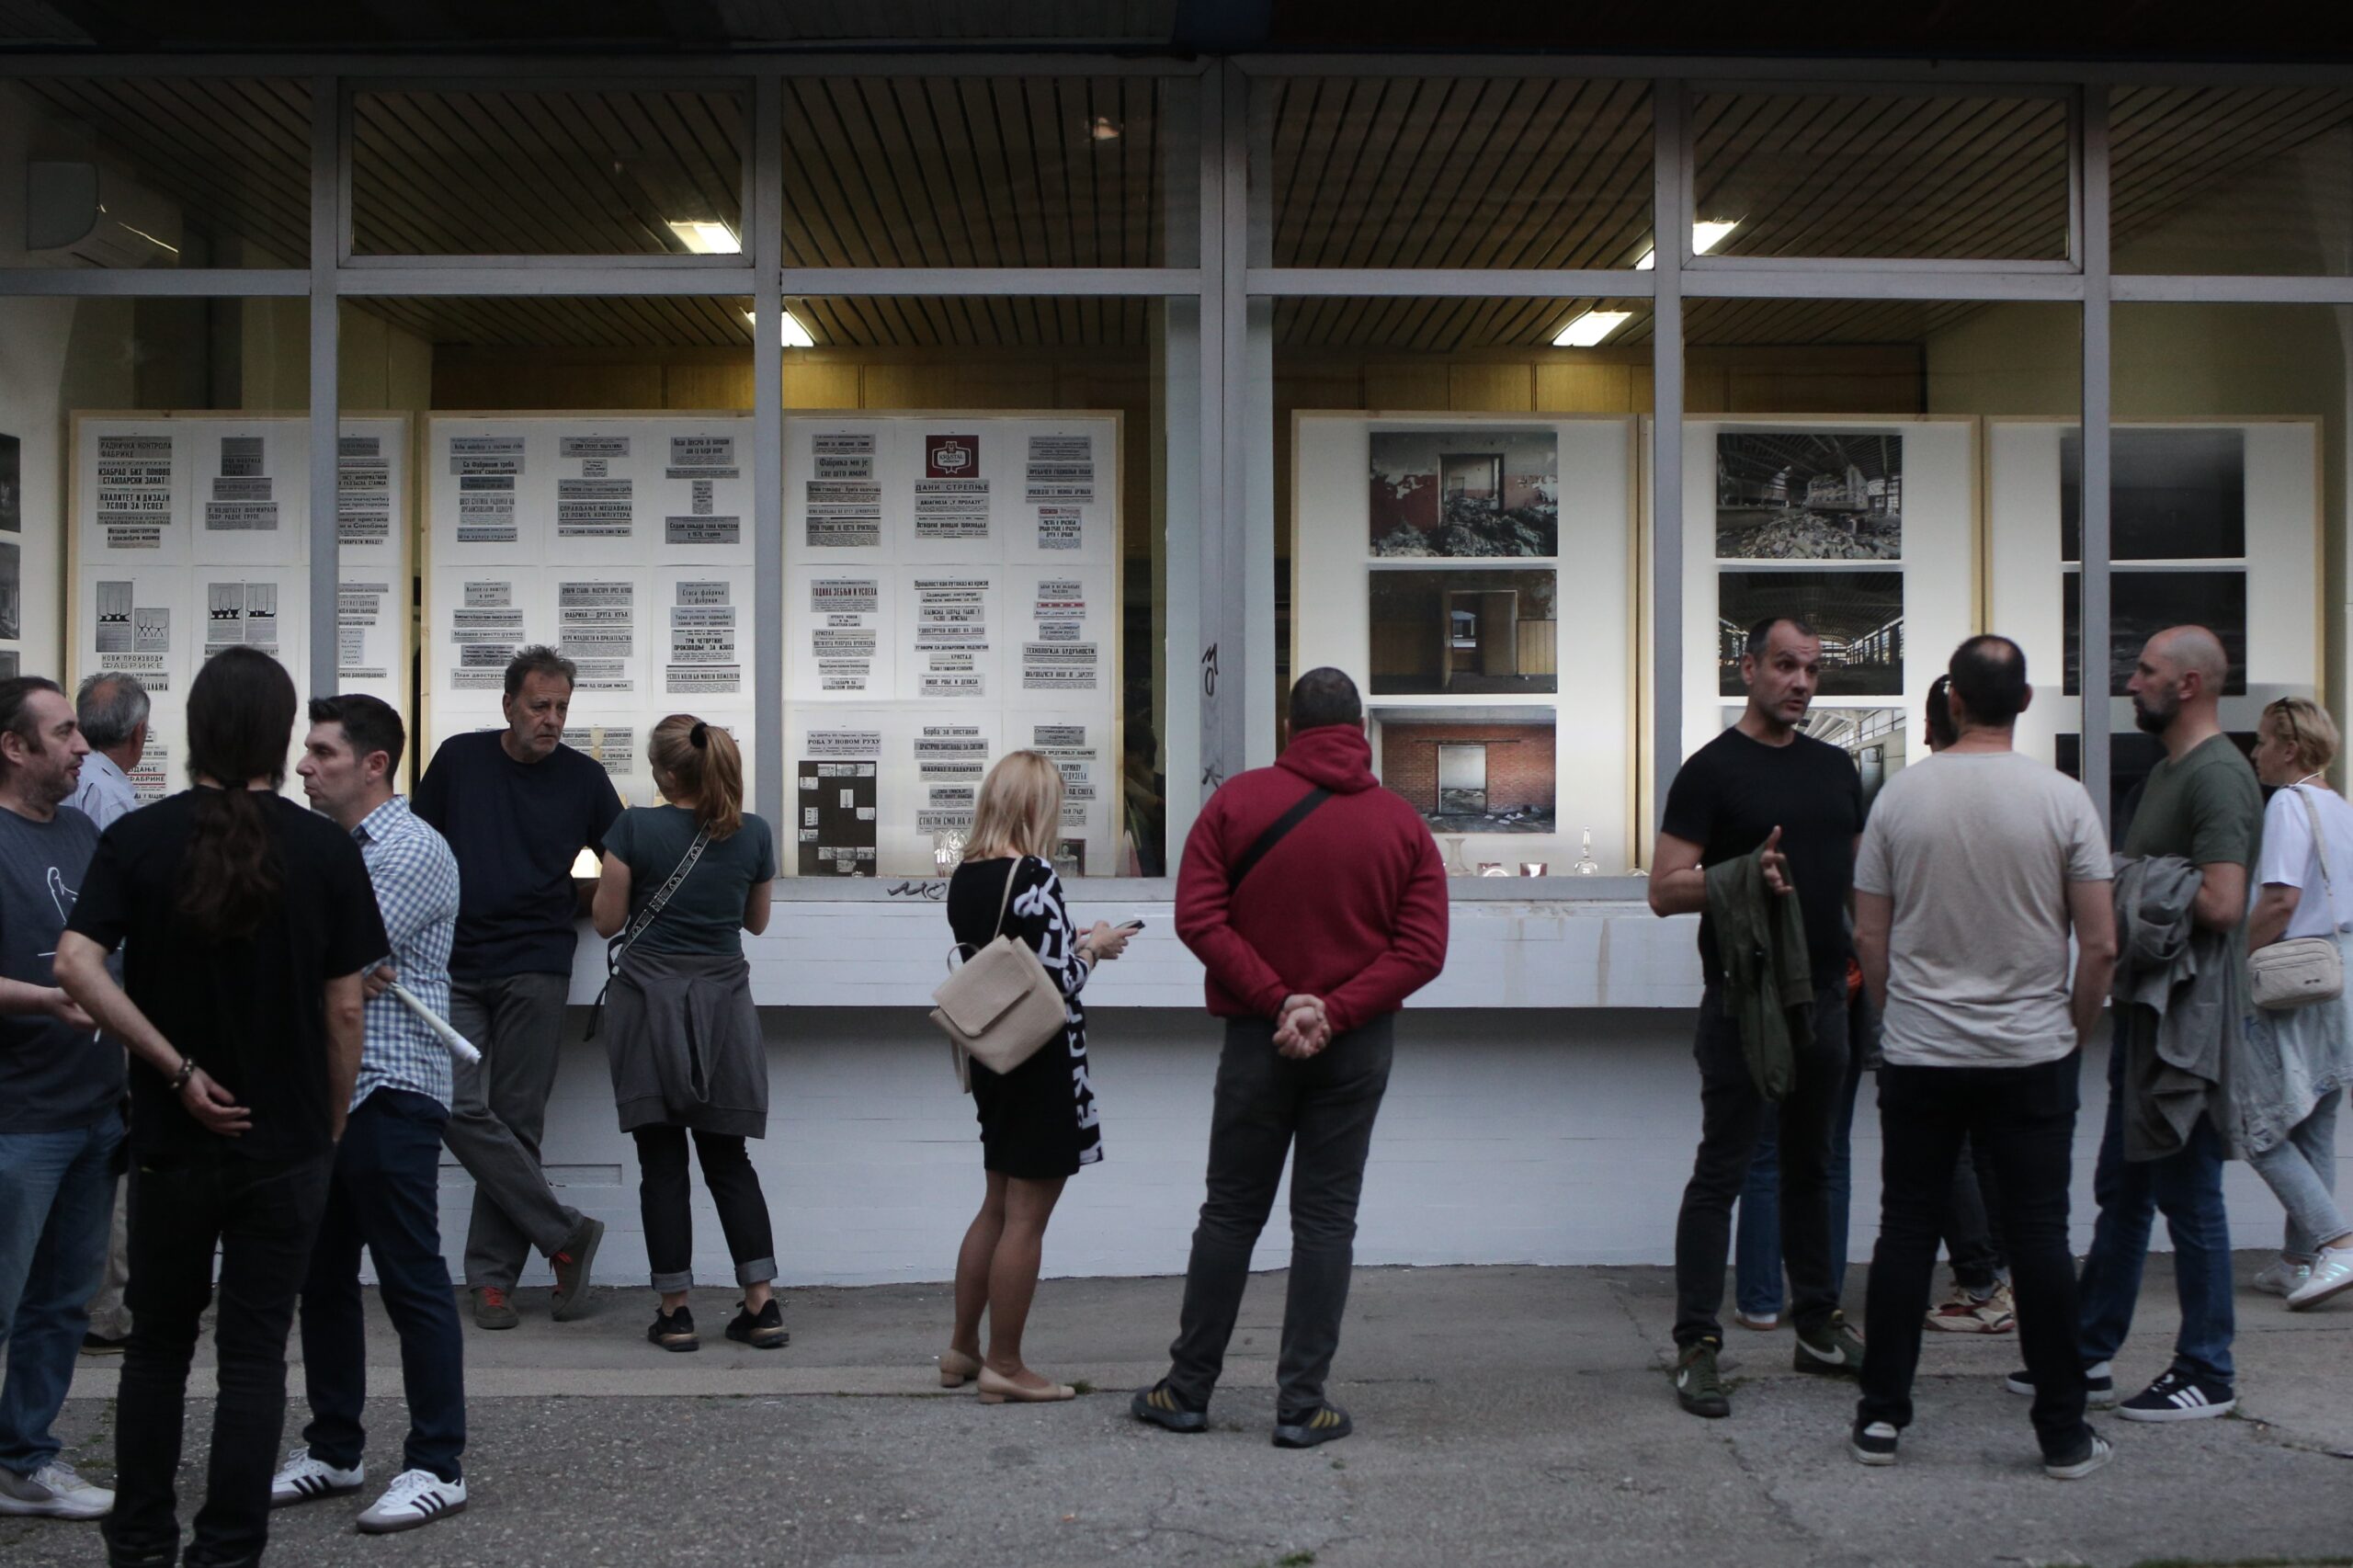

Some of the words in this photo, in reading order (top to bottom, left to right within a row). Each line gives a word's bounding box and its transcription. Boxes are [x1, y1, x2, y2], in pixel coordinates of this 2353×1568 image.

[819, 458, 848, 468] Фабрика
[862, 458, 868, 468] је
[813, 588, 832, 596] ГОДИНА
[859, 588, 877, 596] УСПЕХА
